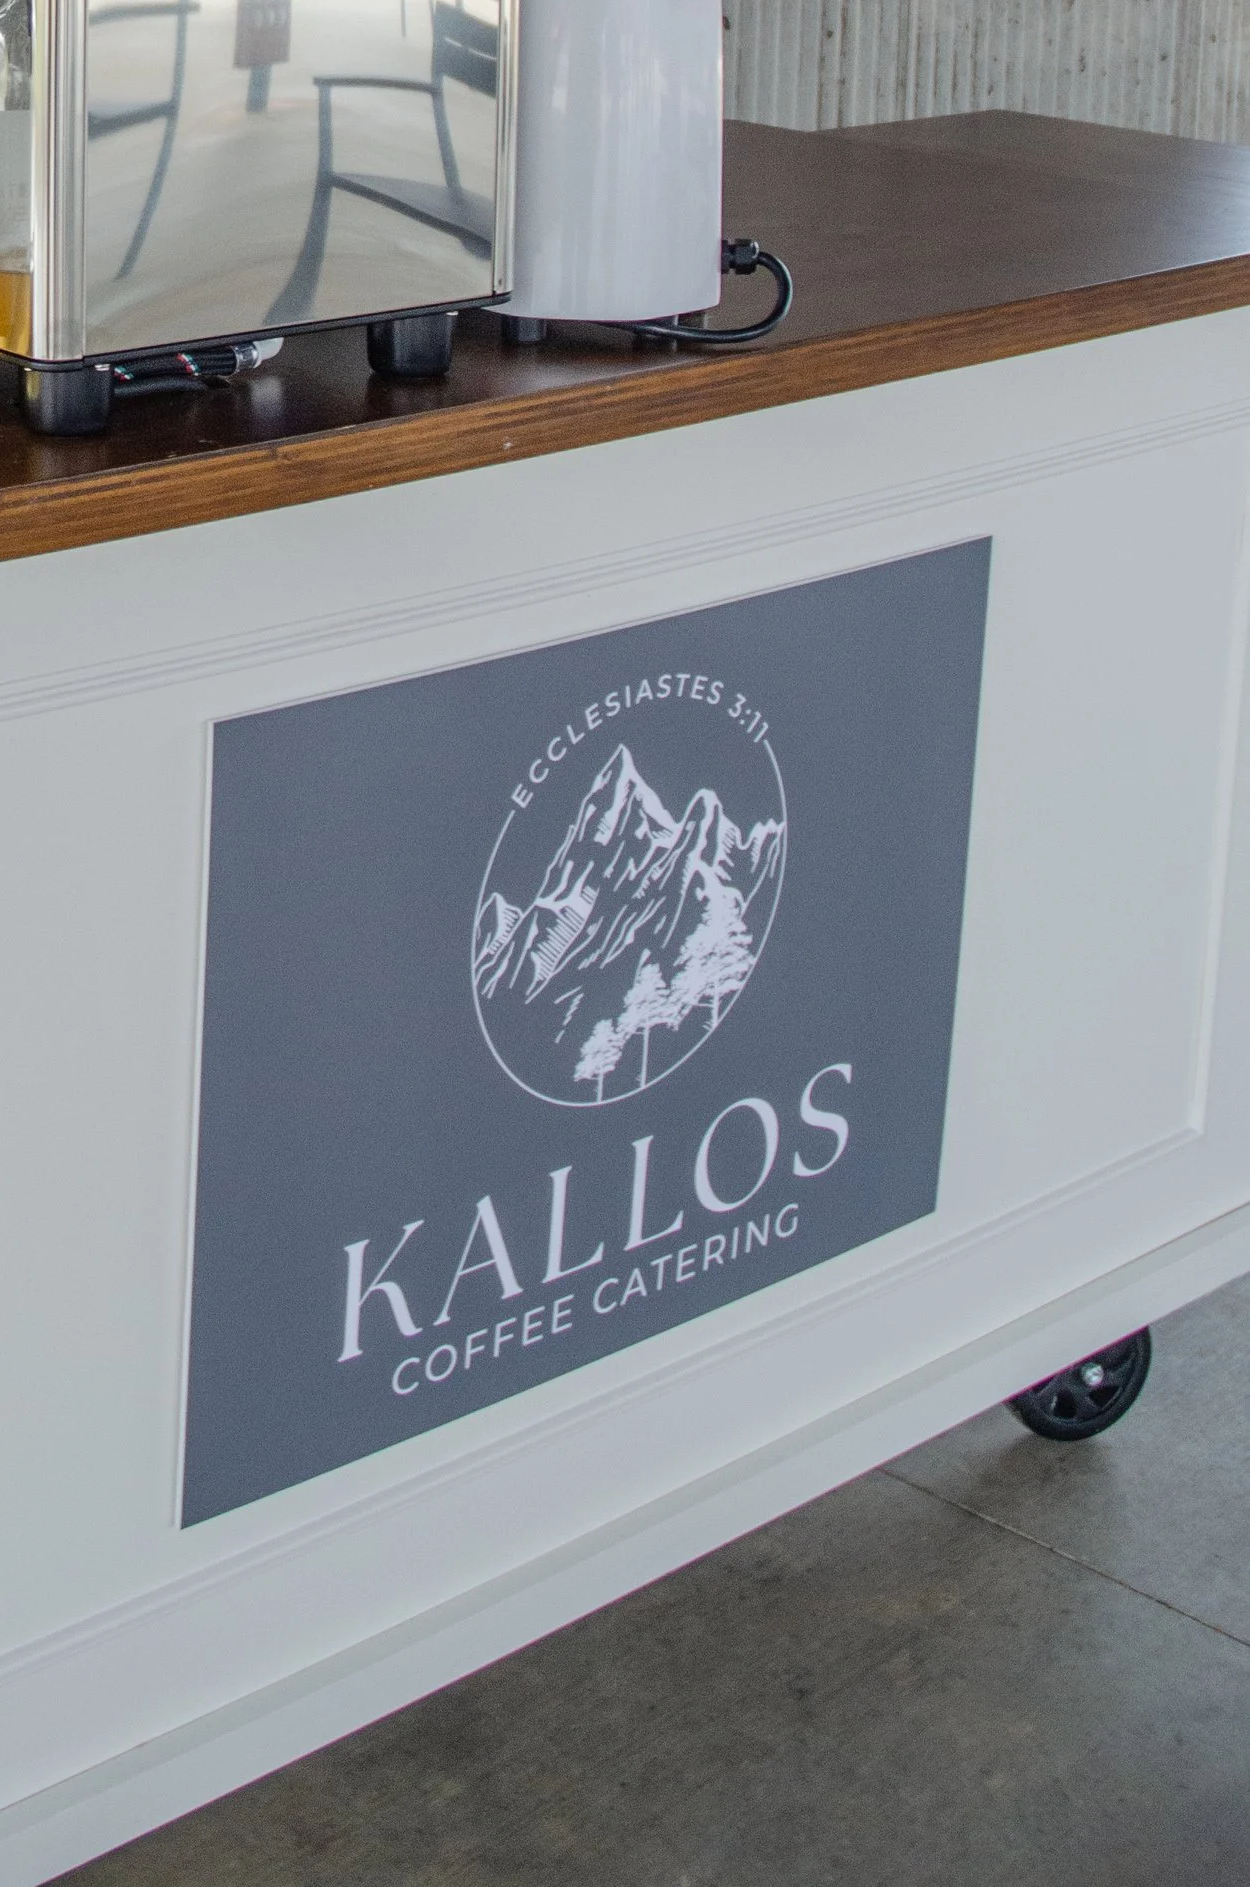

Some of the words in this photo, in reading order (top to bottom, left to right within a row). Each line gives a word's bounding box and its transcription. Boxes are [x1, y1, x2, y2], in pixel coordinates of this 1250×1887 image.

[510, 672, 725, 810] ECCLESIASTES
[728, 693, 769, 743] 3:11
[337, 1062, 853, 1364] KALLOS
[391, 1293, 575, 1396] COFFEE
[592, 1202, 800, 1315] CATERING
